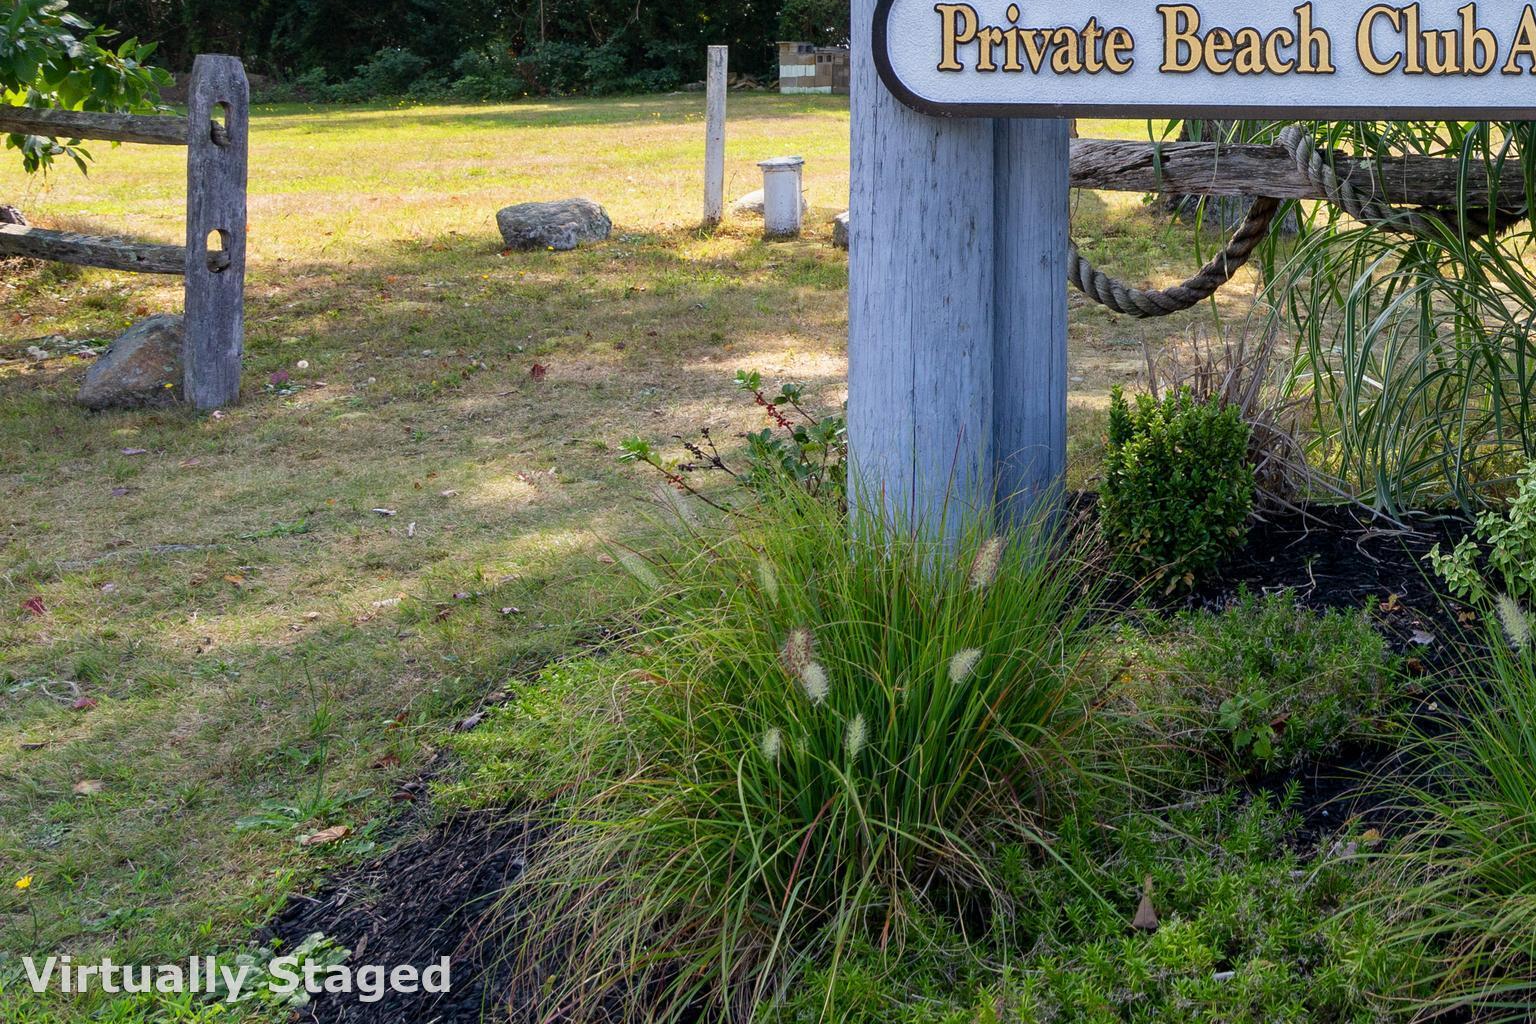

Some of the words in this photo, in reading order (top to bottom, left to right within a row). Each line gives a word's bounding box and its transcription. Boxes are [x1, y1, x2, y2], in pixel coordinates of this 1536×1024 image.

[934, 2, 1134, 75] Private
[1156, 1, 1336, 75] Beach
[1355, 1, 1498, 76] Club
